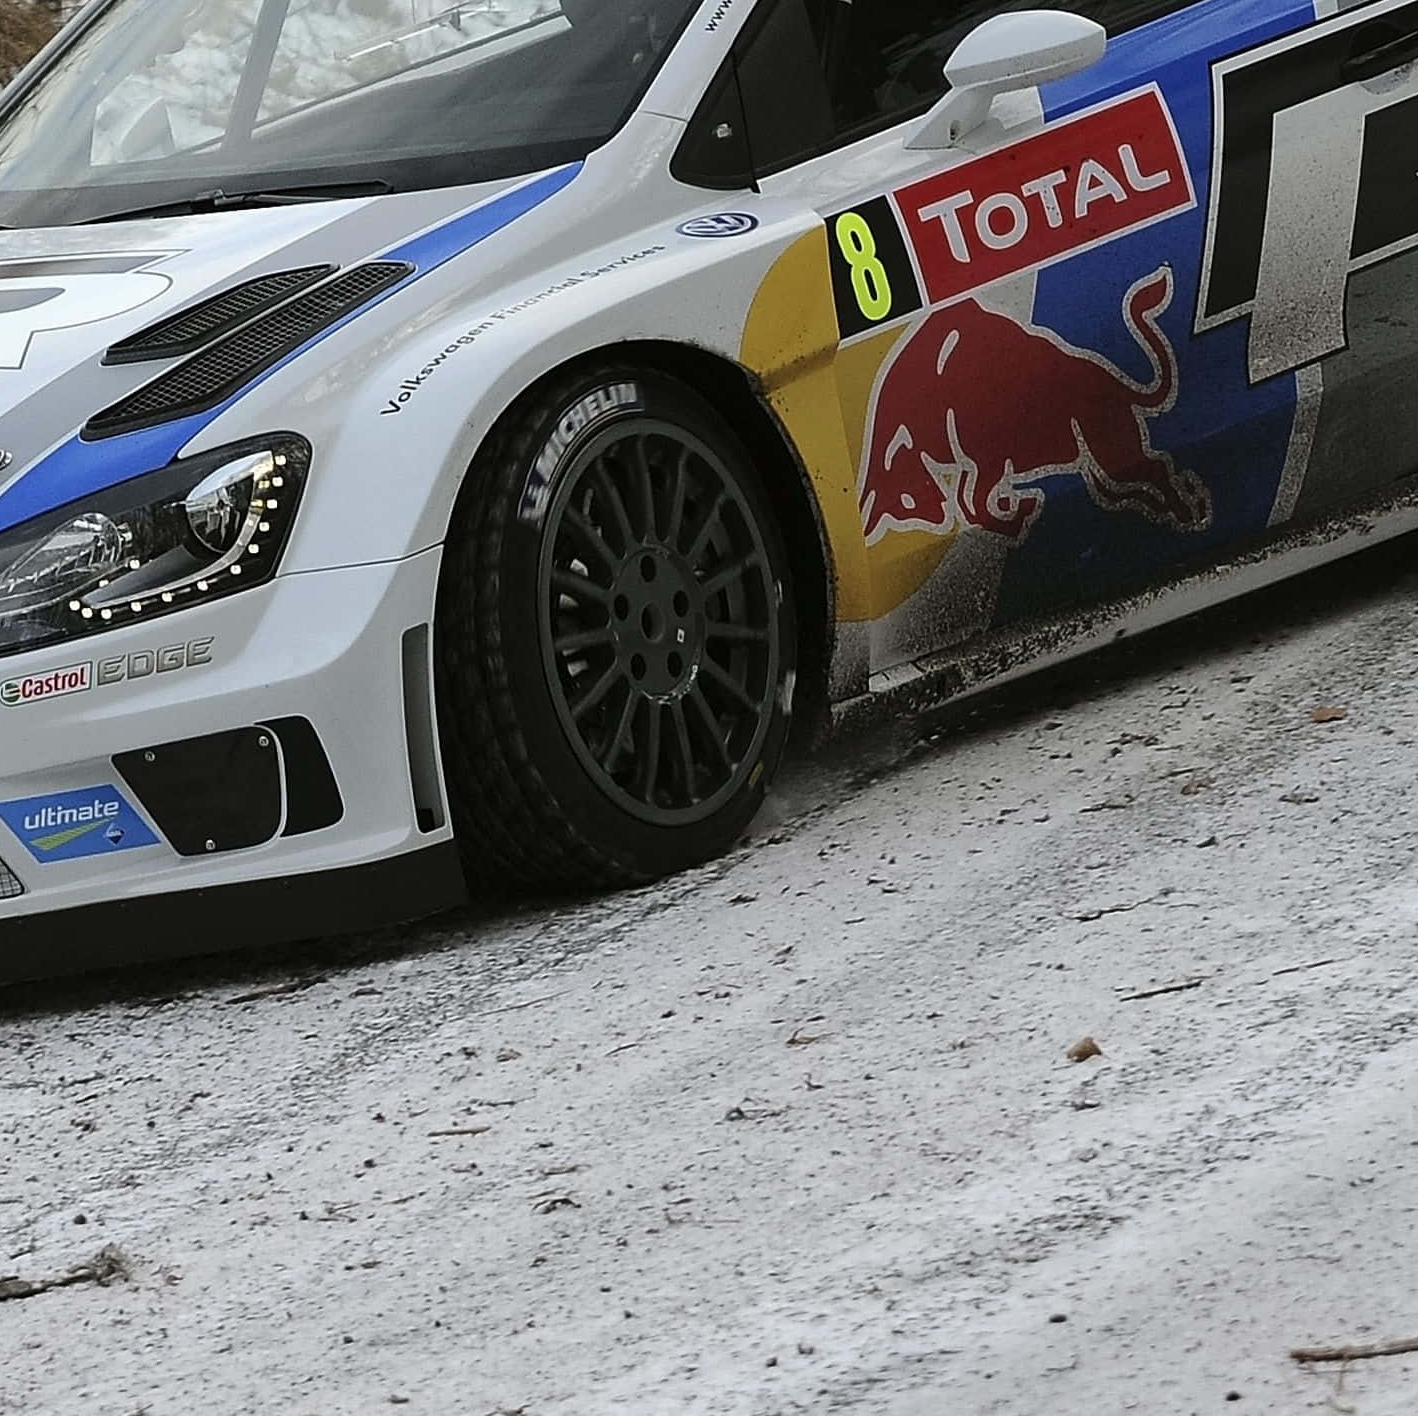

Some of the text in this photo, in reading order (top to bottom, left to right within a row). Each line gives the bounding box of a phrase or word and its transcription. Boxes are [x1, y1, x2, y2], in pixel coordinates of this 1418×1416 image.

[916, 143, 1171, 264] TOTAL
[835, 211, 892, 321] 8
[379, 243, 668, 417] Volkswagen Financial Services
[21, 636, 215, 699] Castrol EDGE
[23, 799, 119, 830] ultimate
